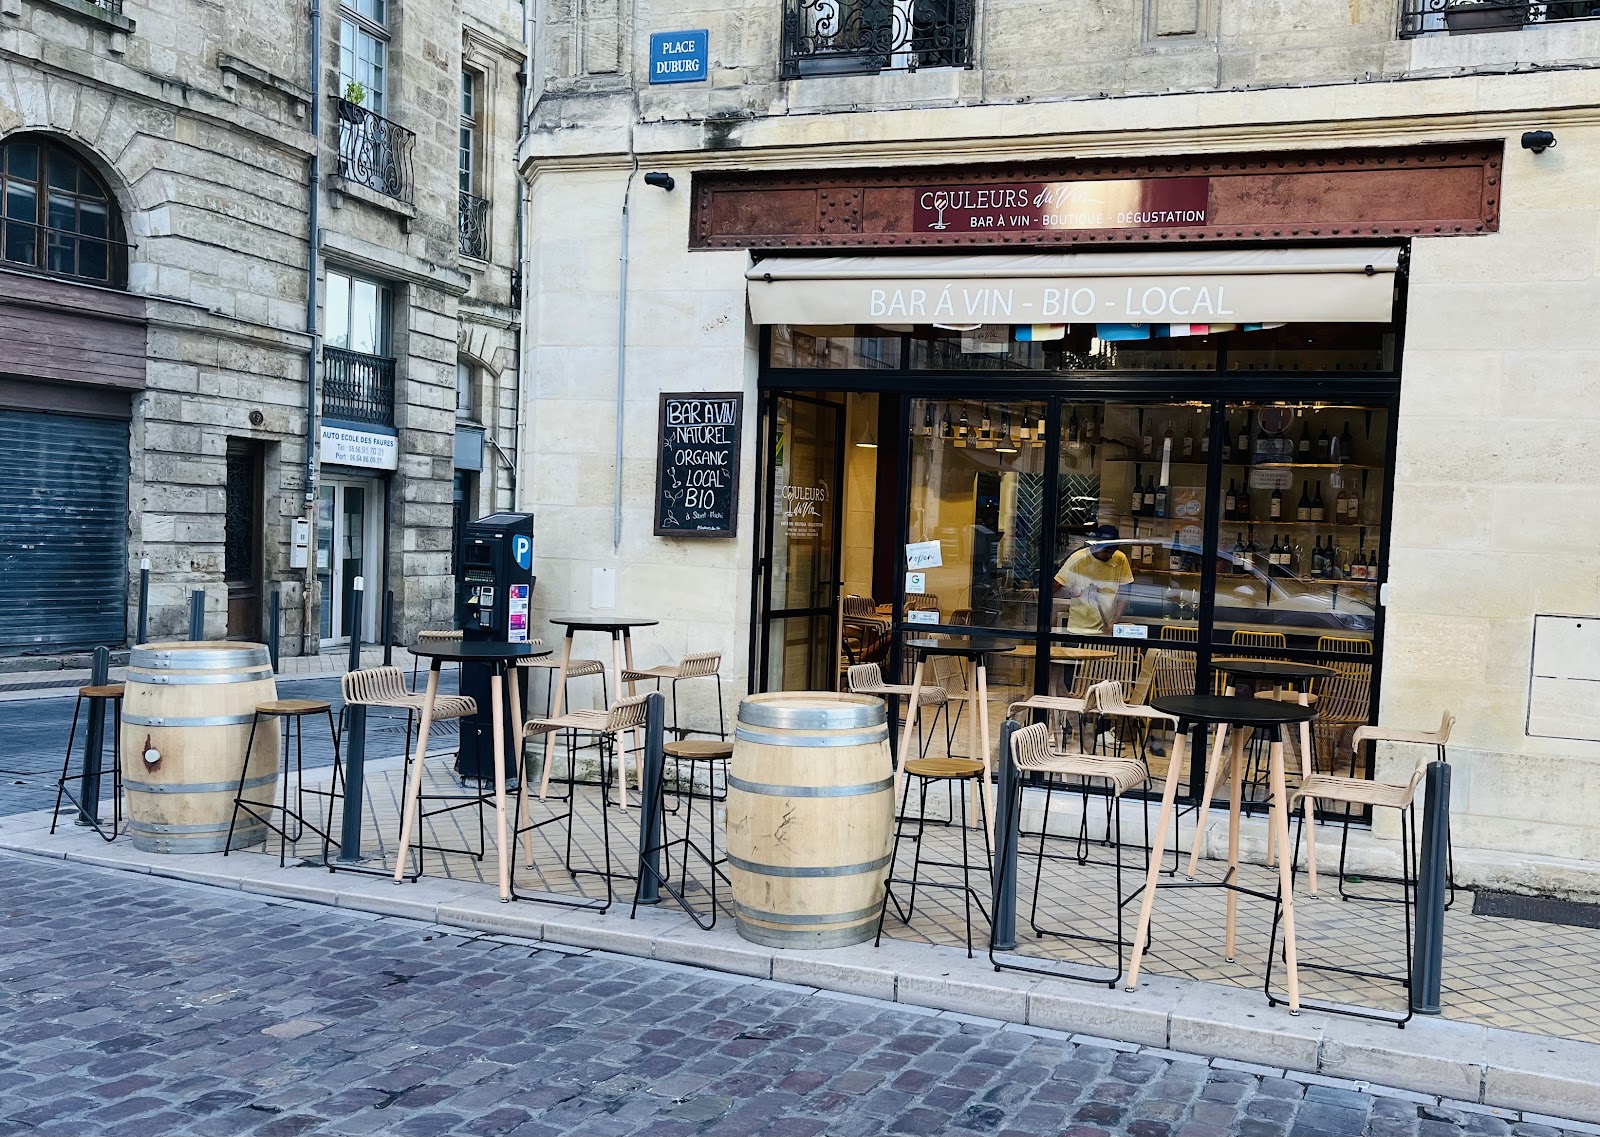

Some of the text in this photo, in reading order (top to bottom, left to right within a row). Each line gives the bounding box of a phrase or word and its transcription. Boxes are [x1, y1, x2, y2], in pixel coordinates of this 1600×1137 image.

[662, 40, 695, 54] PLACE
[656, 59, 700, 74] DUBURG
[920, 188, 1029, 210] COULEURS
[1032, 186, 1054, 209] du
[970, 215, 994, 228] BAR
[997, 213, 1006, 227] À
[1009, 214, 1030, 227] VIN
[1042, 212, 1104, 226] BOUTIQUE
[1117, 210, 1205, 225] DÉGUSTATION
[869, 288, 927, 316] BAR
[962, 288, 1014, 316] VIN
[1042, 287, 1097, 316] BIO
[1125, 286, 1234, 316] LOCAL
[669, 402, 702, 424] BAR
[714, 401, 735, 424] VIN
[322, 431, 394, 447] AUTO ECOLE DES FAURES
[676, 426, 732, 445] NATUREL
[675, 449, 729, 466] ORGANIC
[685, 469, 725, 488] LOCAL
[684, 487, 715, 510] BIO
[516, 537, 529, 563] P
[911, 575, 920, 584] G
